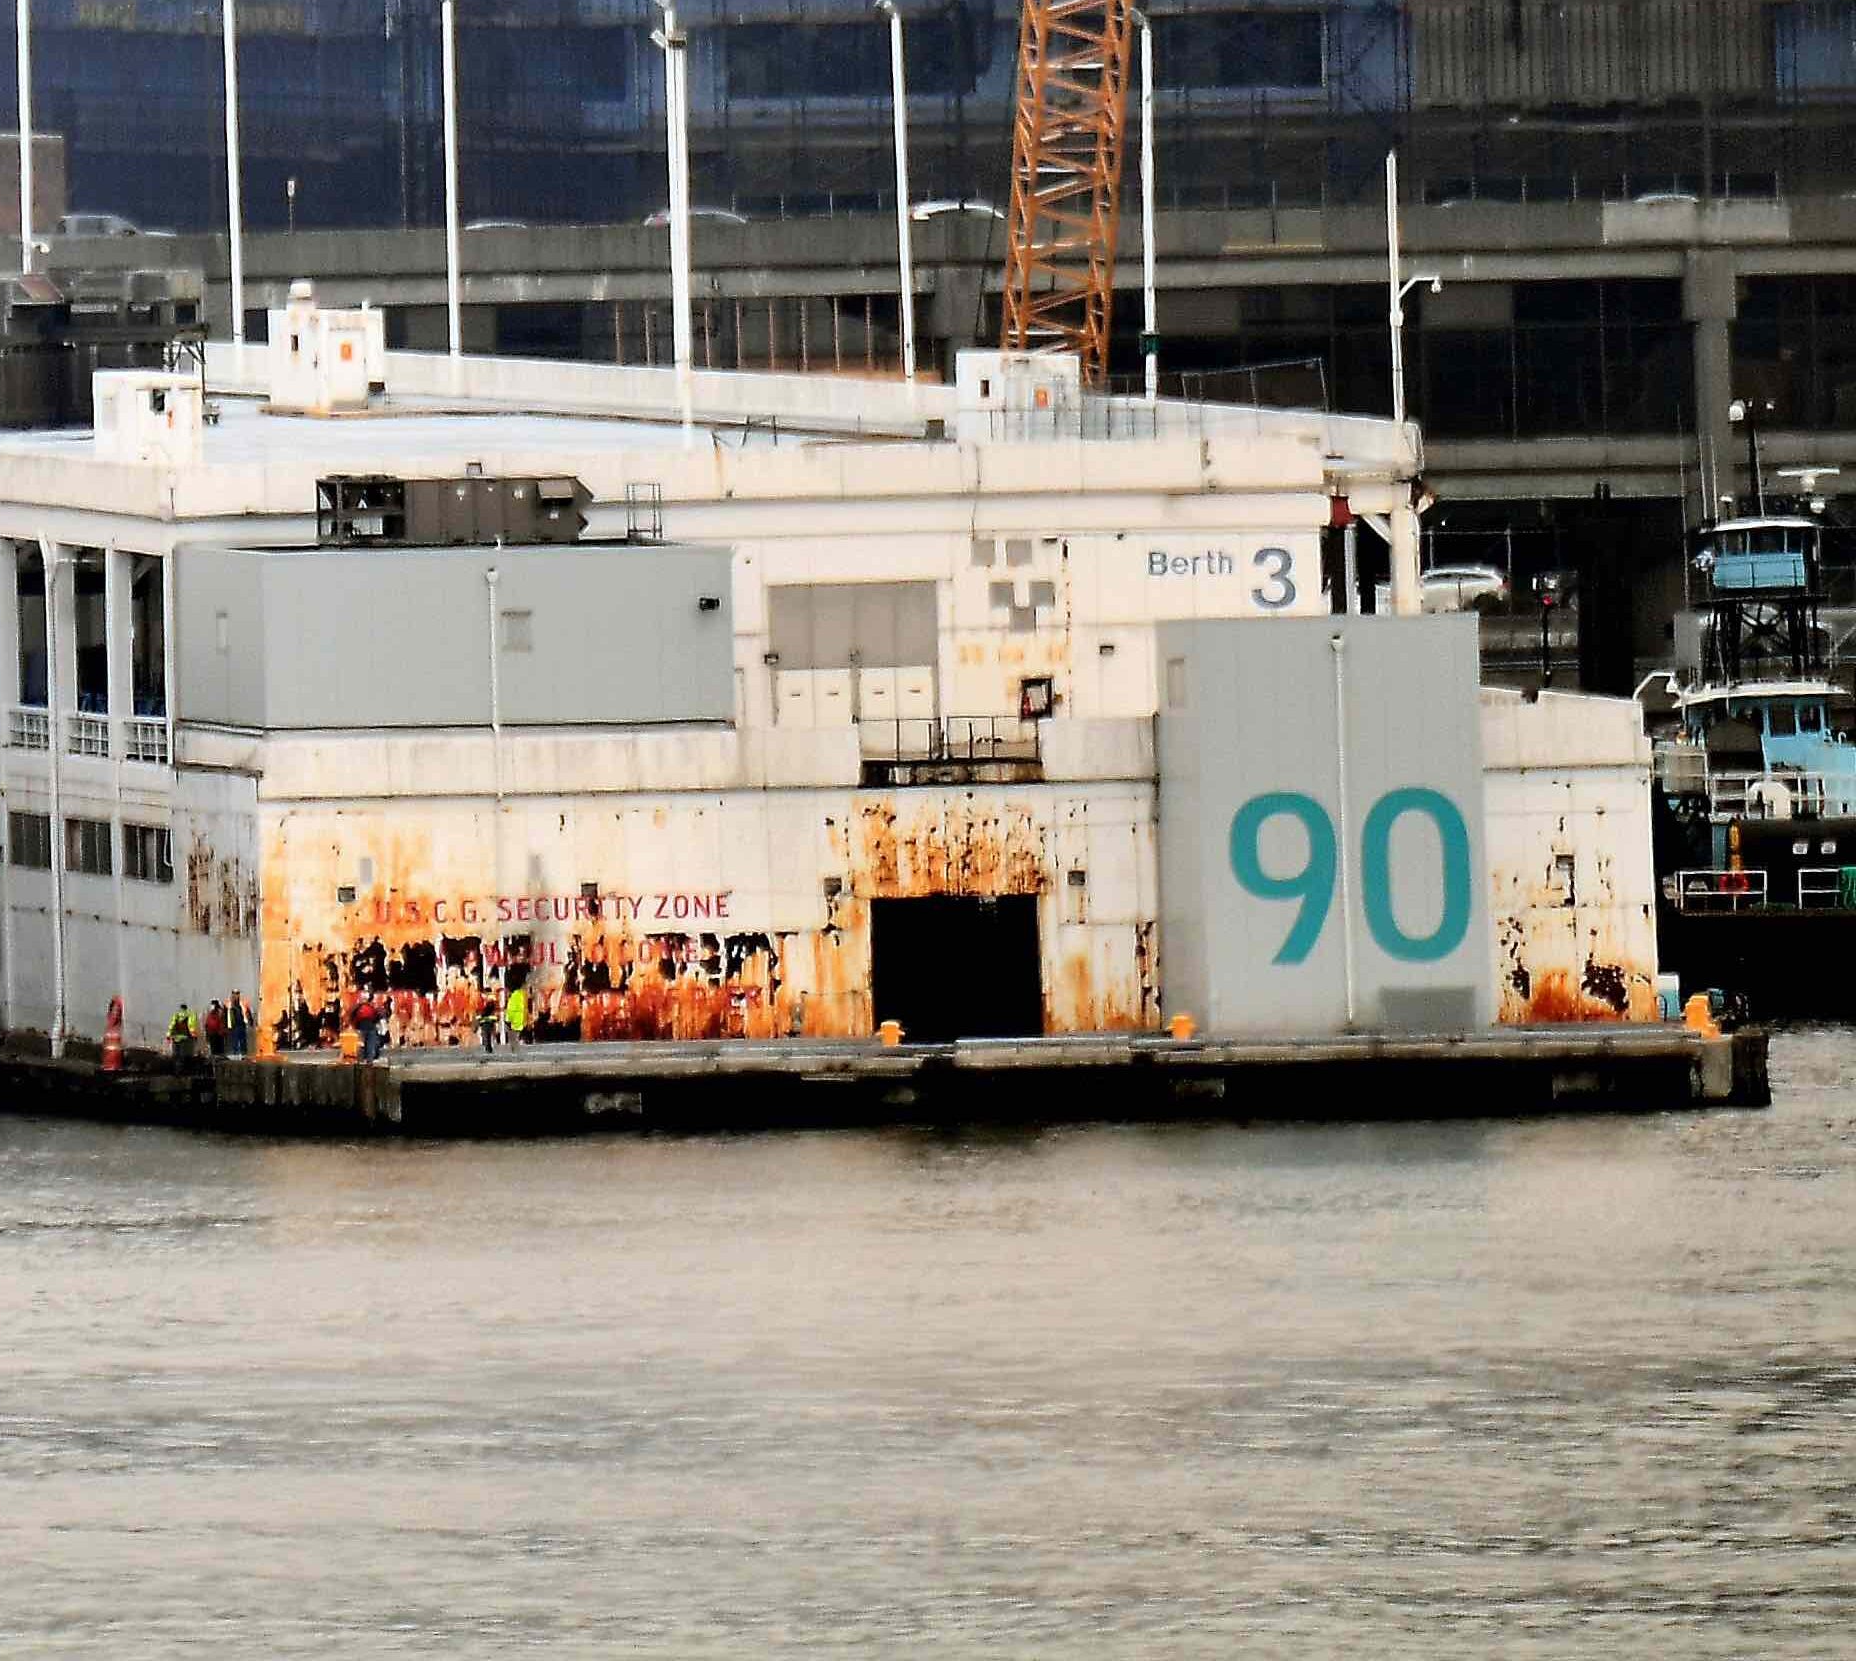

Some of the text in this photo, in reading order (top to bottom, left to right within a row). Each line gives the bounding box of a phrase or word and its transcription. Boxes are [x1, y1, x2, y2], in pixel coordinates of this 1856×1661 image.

[1147, 547, 1297, 610] Berth 3
[1229, 787, 1471, 966] 90
[496, 894, 643, 923] SECURITY
[653, 894, 730, 919] ZONE
